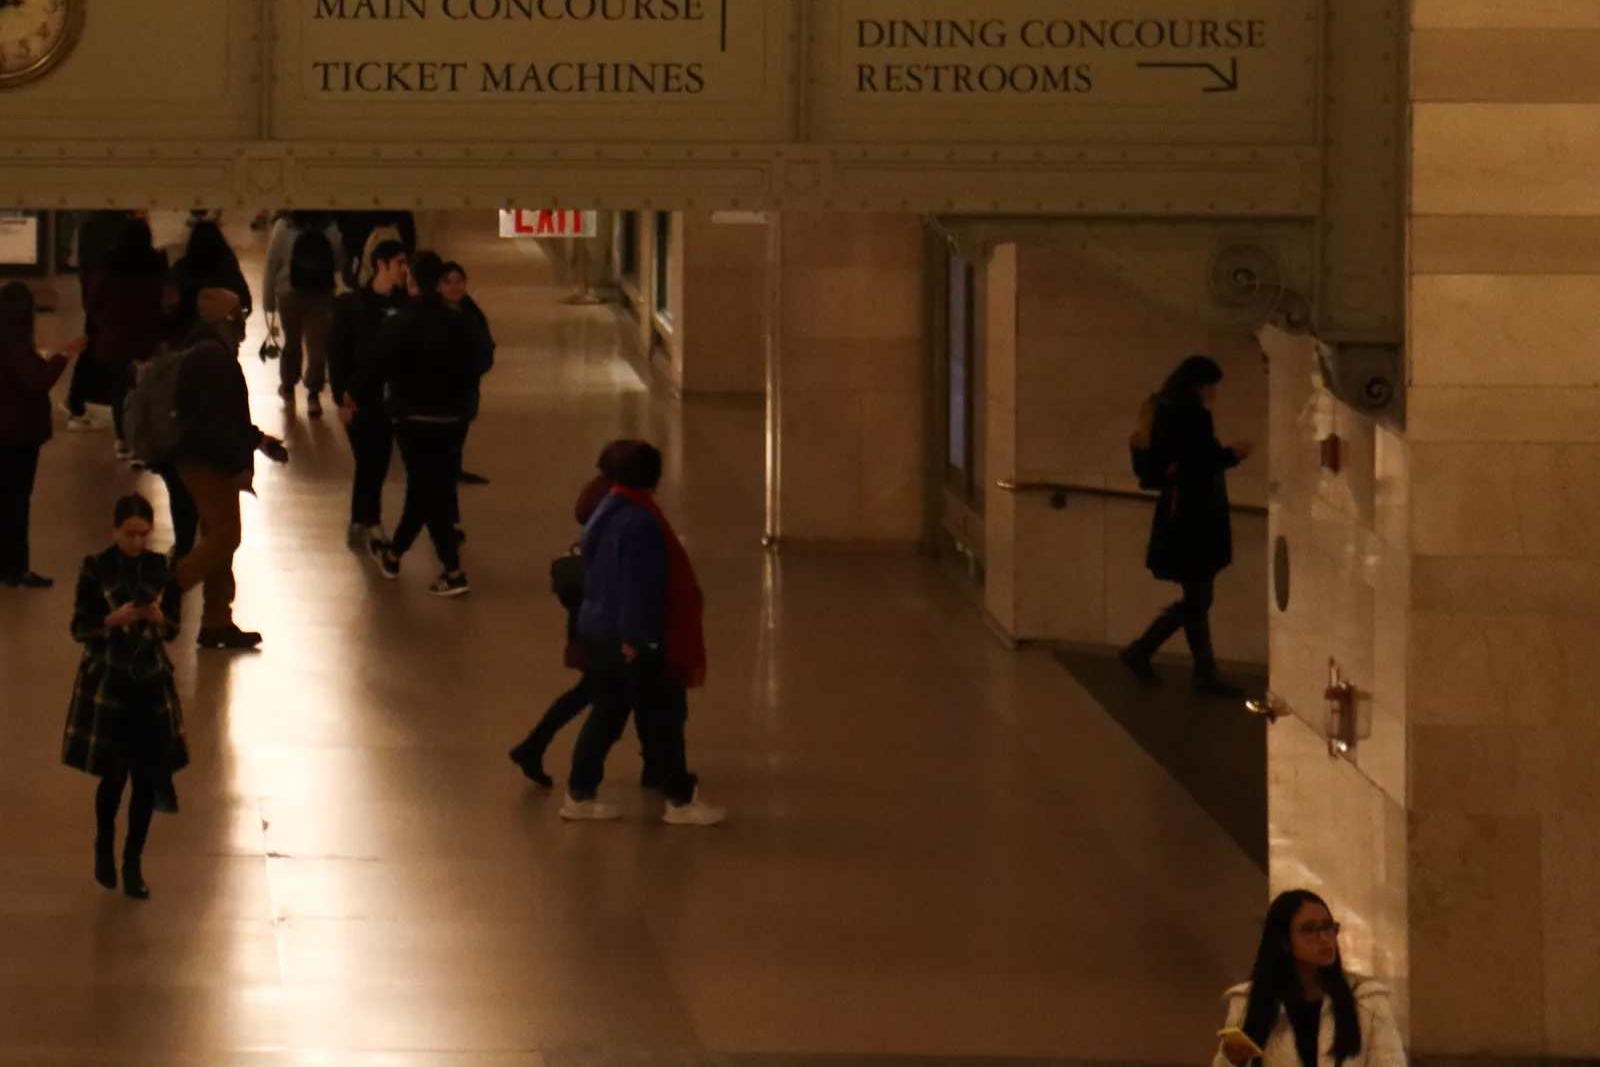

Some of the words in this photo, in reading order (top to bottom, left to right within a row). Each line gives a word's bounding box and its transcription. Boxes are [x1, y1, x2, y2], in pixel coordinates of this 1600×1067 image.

[856, 18, 1007, 48] DINING
[1019, 18, 1266, 48] CONCOURSE
[312, 60, 467, 94] TICKET
[480, 60, 705, 94] MACHINES
[856, 63, 1093, 93] RESTROOMS
